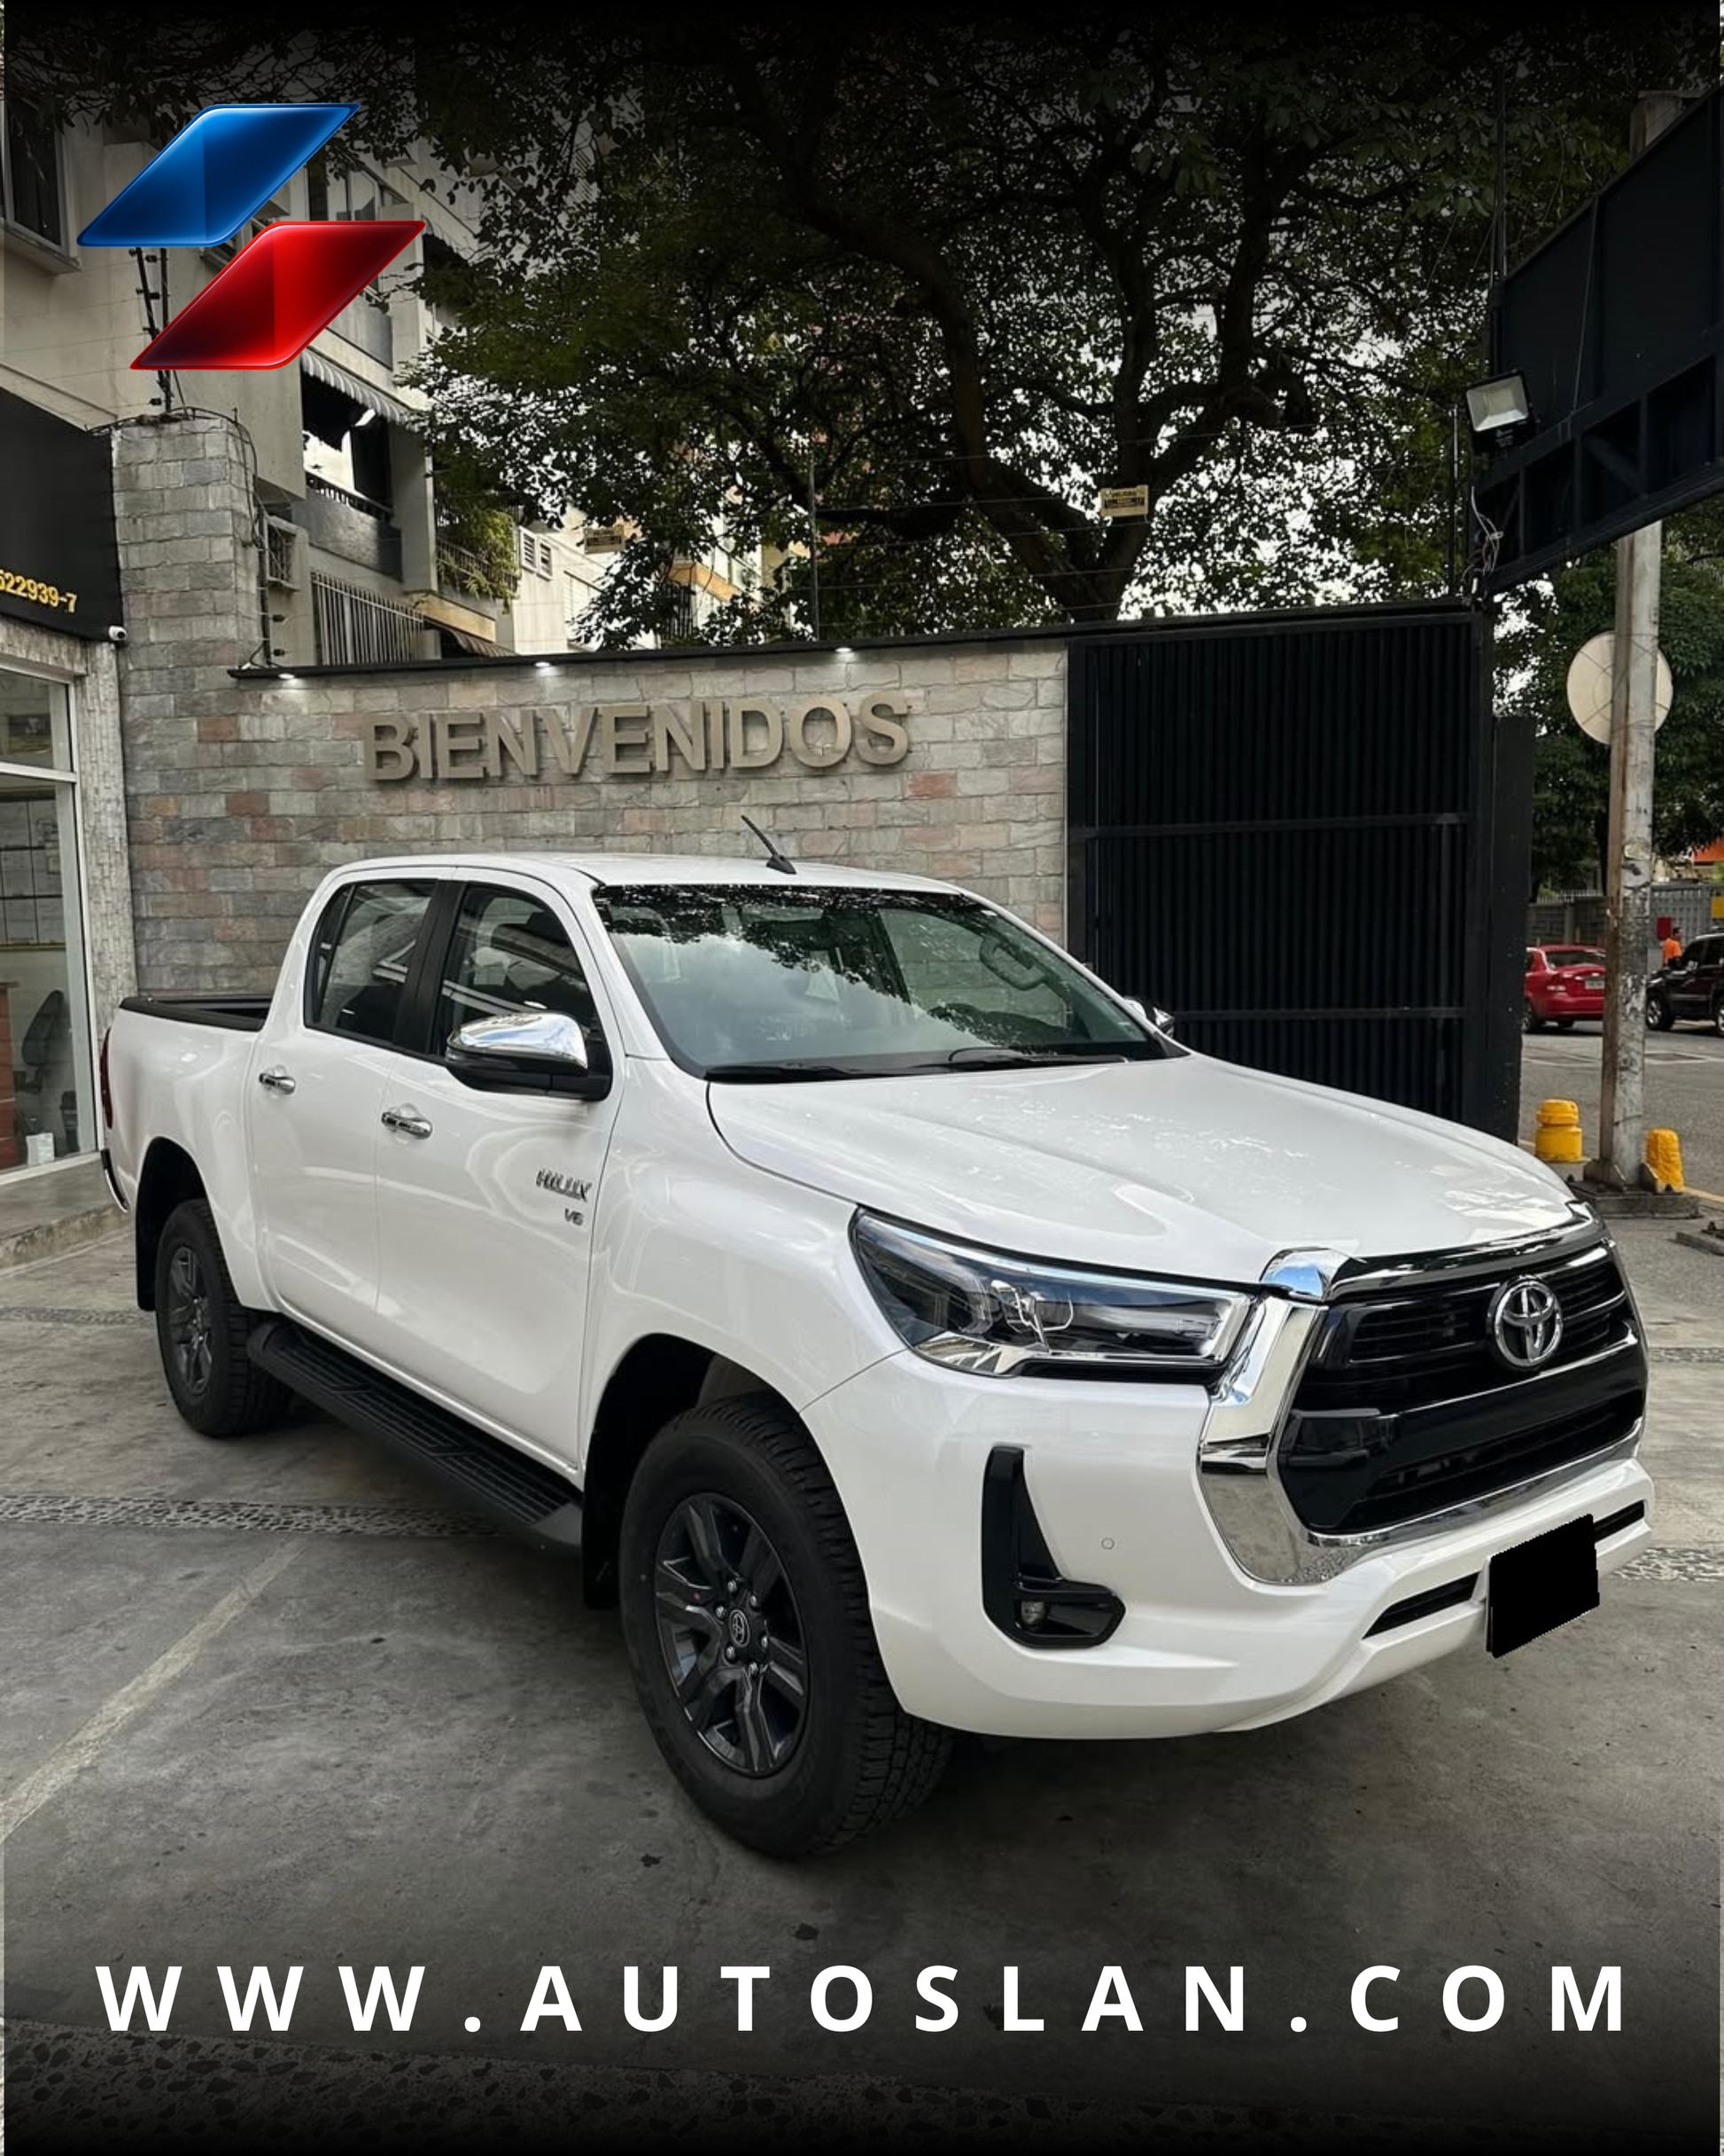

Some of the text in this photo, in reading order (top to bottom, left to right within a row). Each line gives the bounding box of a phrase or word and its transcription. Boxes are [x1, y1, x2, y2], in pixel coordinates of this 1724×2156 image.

[363, 690, 908, 781] BIENVENIDOS
[536, 1168, 592, 1203] HILUX
[564, 1208, 585, 1226] V6
